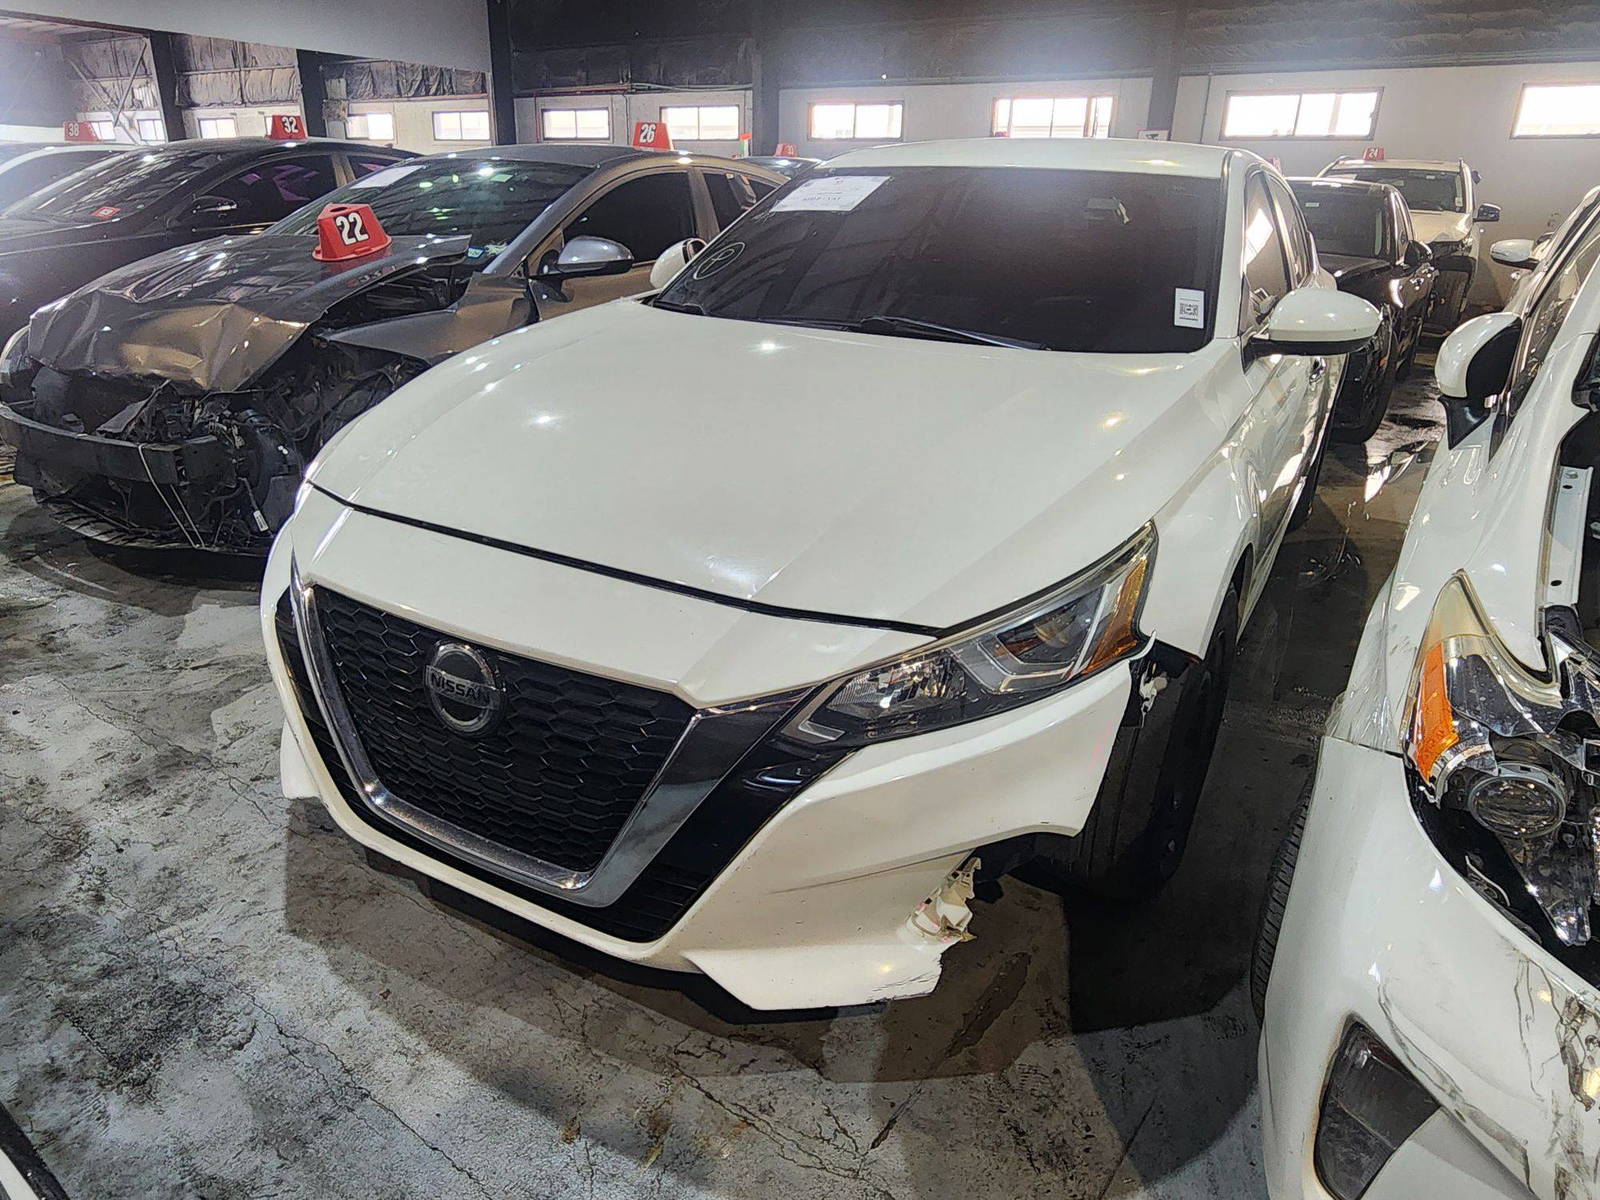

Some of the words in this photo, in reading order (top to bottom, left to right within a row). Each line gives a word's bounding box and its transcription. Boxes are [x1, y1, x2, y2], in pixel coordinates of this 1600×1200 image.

[282, 116, 299, 133] 32
[639, 123, 656, 143] 26
[335, 210, 370, 244] 22
[430, 671, 491, 706] NISSAN
